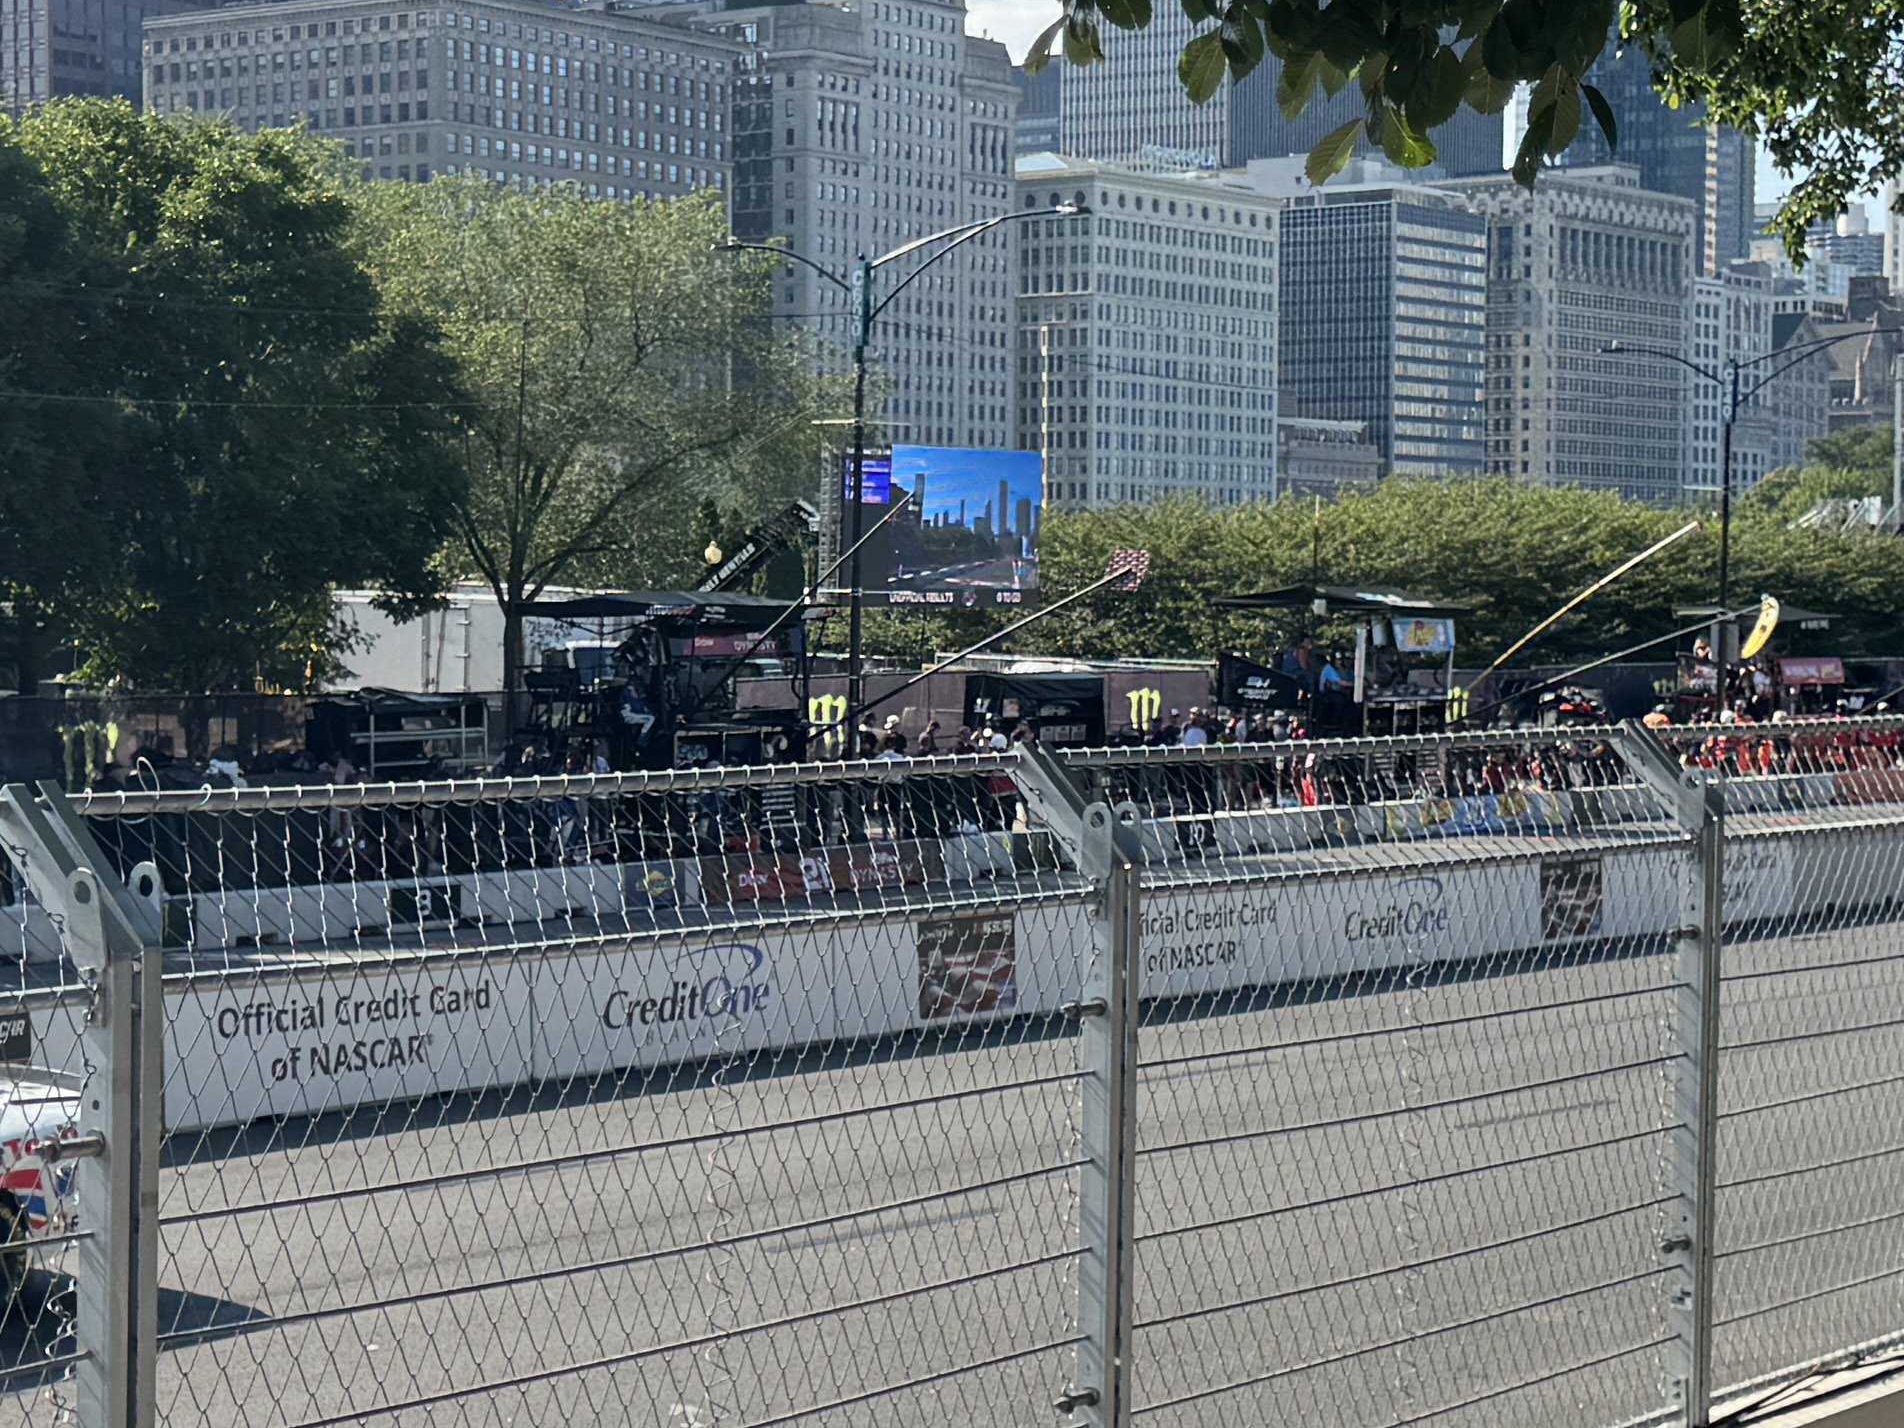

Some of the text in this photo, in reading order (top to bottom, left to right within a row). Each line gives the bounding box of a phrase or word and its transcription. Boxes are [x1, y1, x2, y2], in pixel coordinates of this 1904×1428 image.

[417, 888, 432, 917] 8
[1184, 905, 1235, 933] Credit
[1240, 899, 1277, 927] Card
[217, 978, 492, 1040] Official Credit Card
[271, 1046, 300, 1082] of
